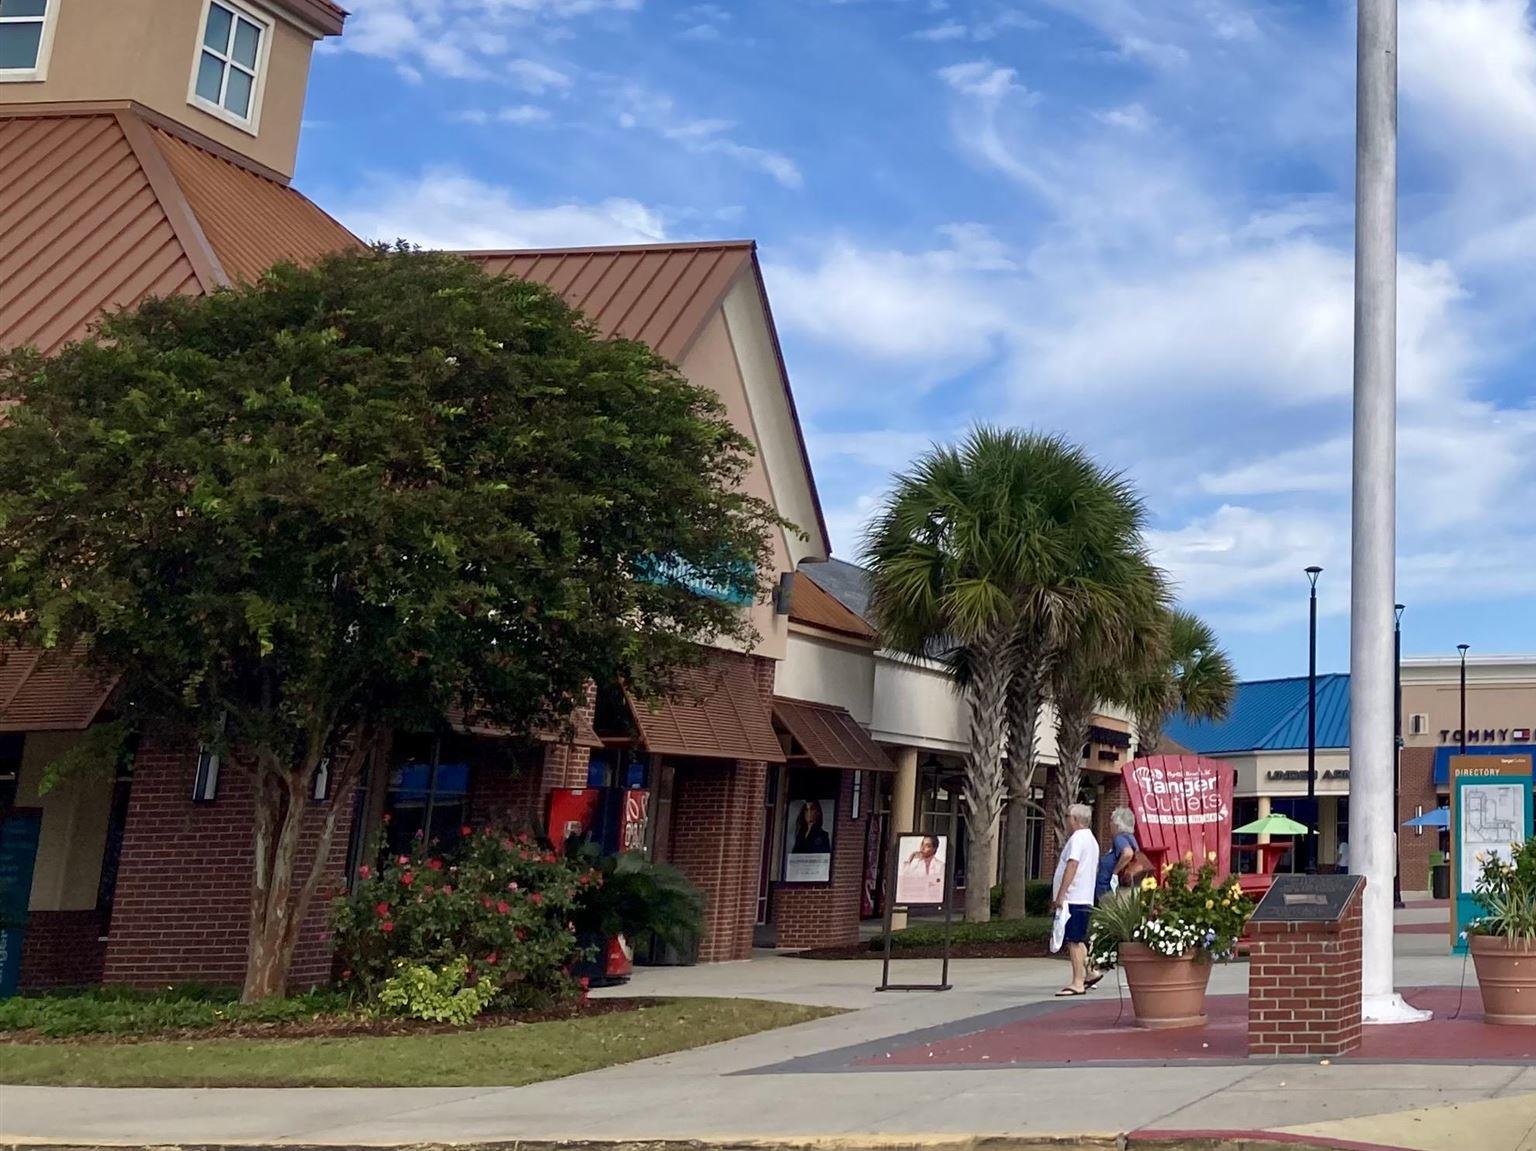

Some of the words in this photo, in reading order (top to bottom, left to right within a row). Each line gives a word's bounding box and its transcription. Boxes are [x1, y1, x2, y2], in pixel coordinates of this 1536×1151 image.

[1439, 728, 1509, 743] TOMMY
[1454, 768, 1500, 777] DIRECTORY
[1141, 776, 1217, 798] Tanger
[1144, 792, 1223, 813] Outlets
